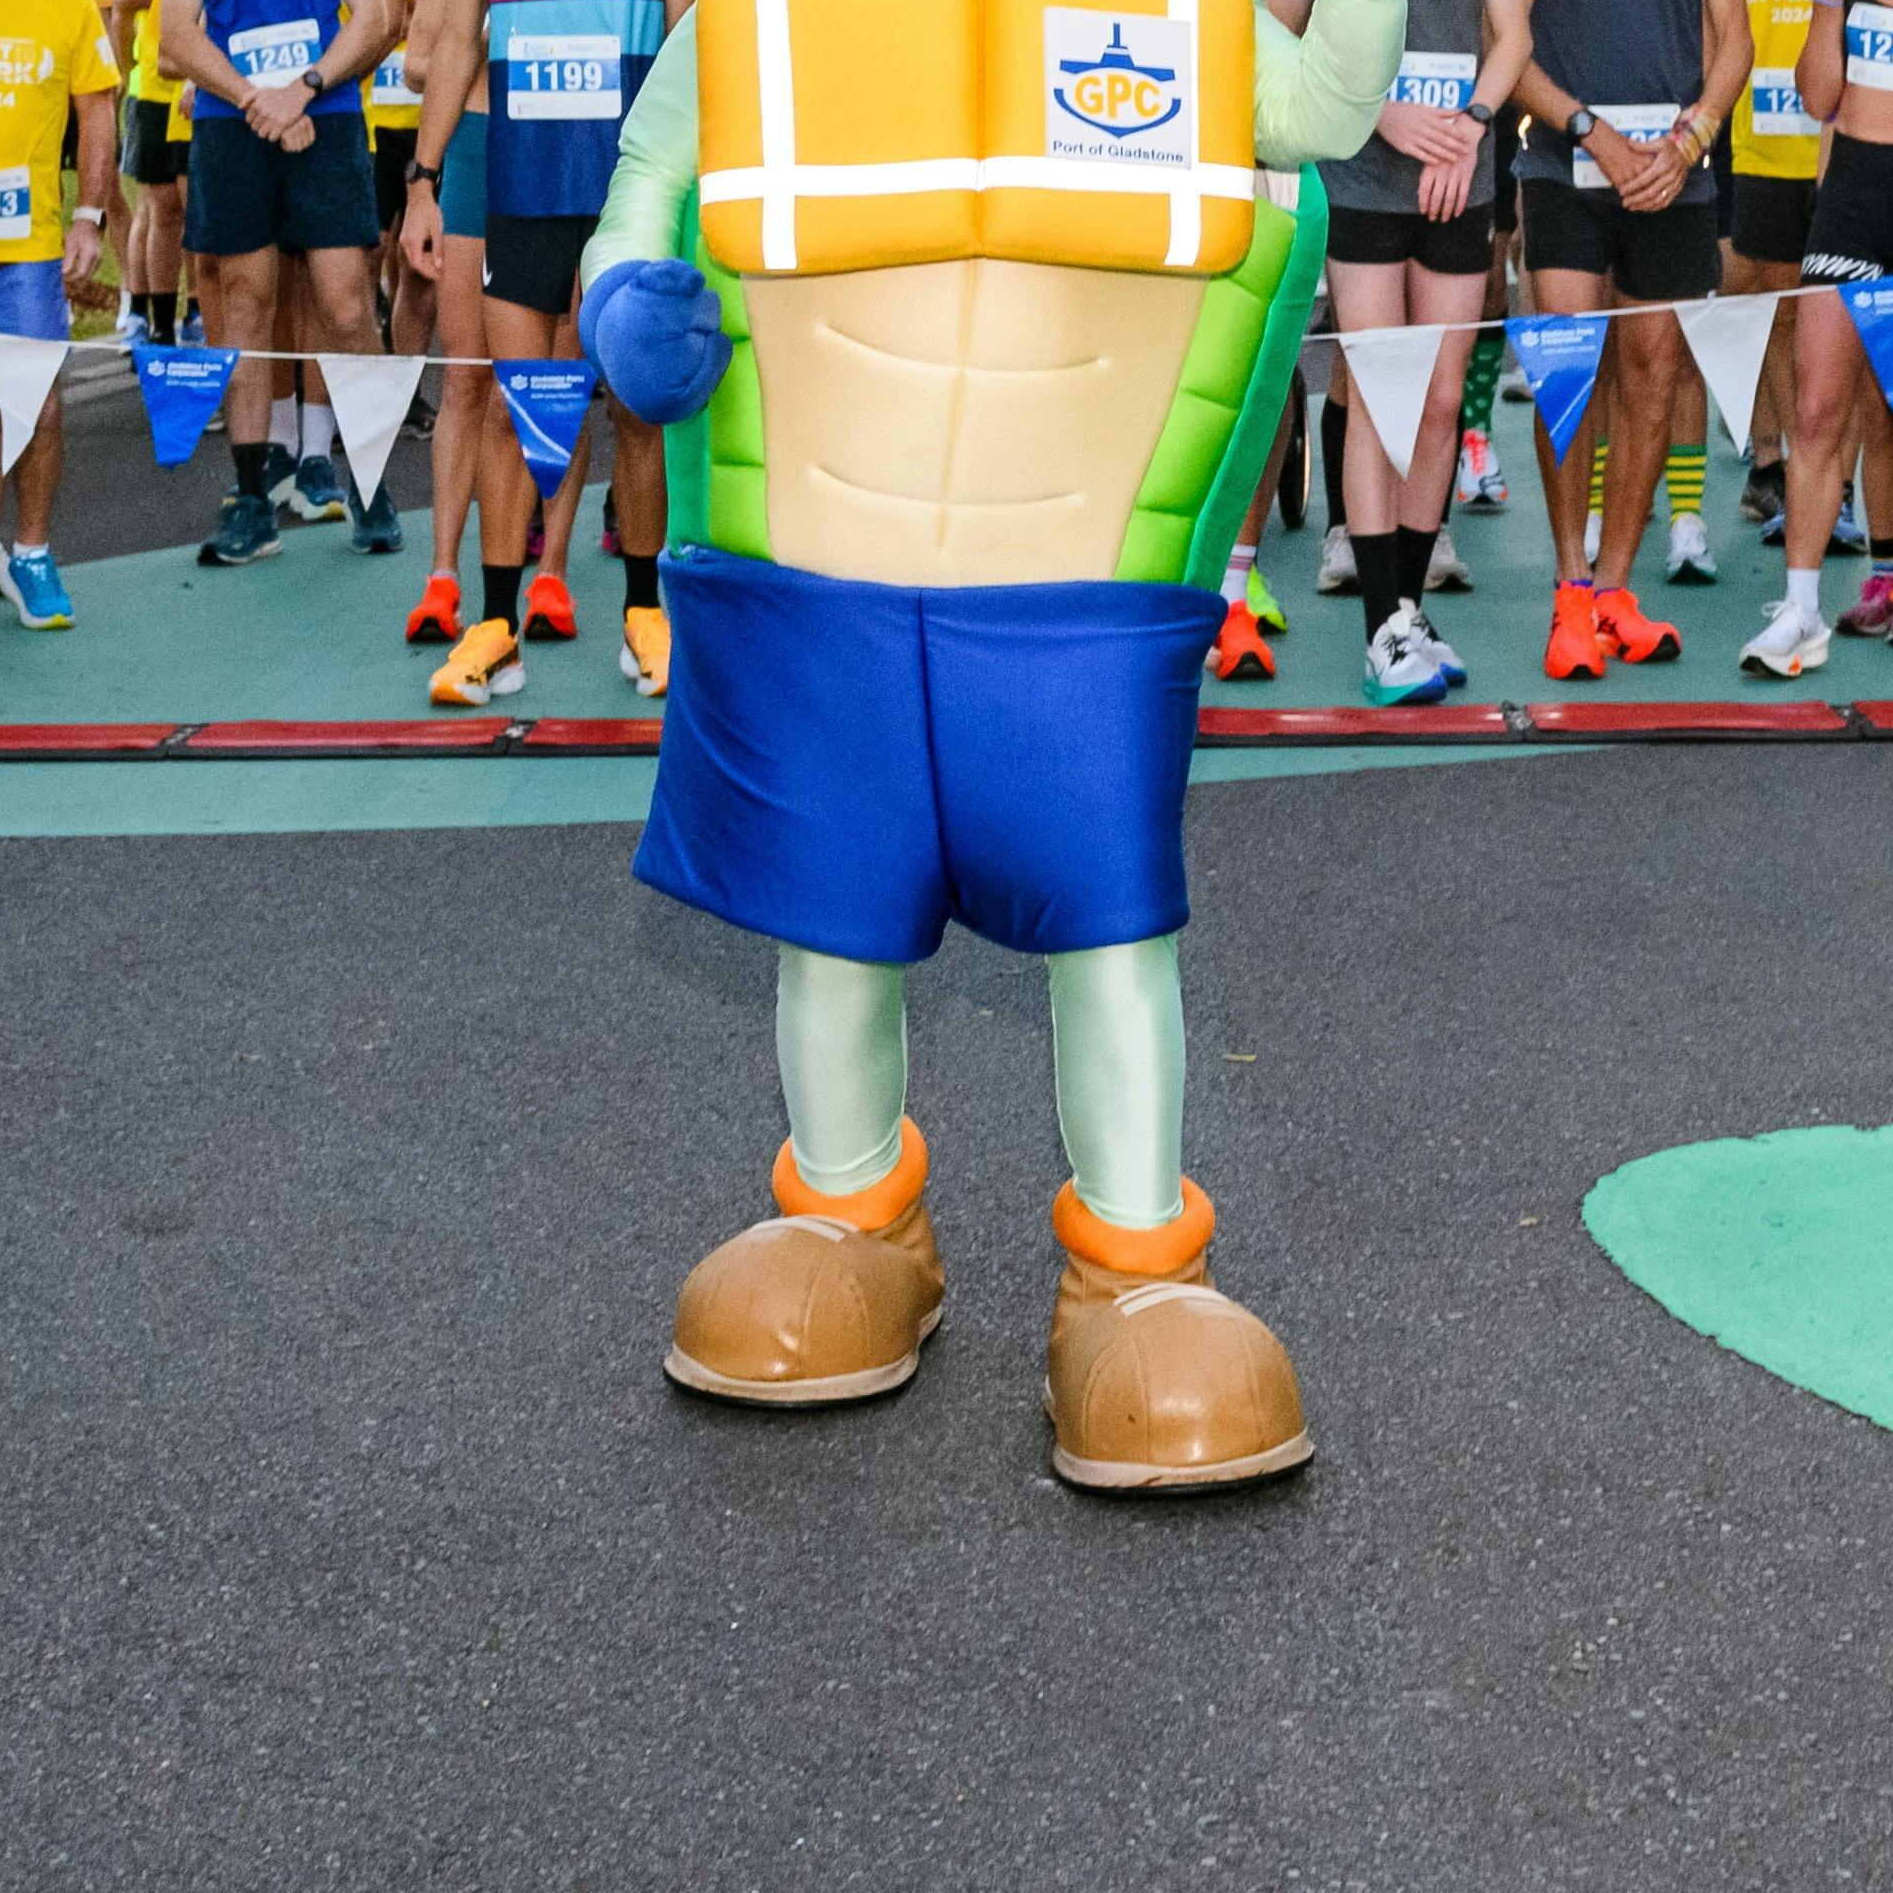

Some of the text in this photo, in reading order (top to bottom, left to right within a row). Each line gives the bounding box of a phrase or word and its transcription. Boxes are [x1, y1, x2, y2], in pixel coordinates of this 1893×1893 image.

[244, 41, 310, 75] 1249
[525, 60, 603, 92] 1199
[1387, 76, 1460, 109] 1309
[1074, 73, 1163, 119] GPC
[1053, 140, 1184, 163] Port of Gladstone
